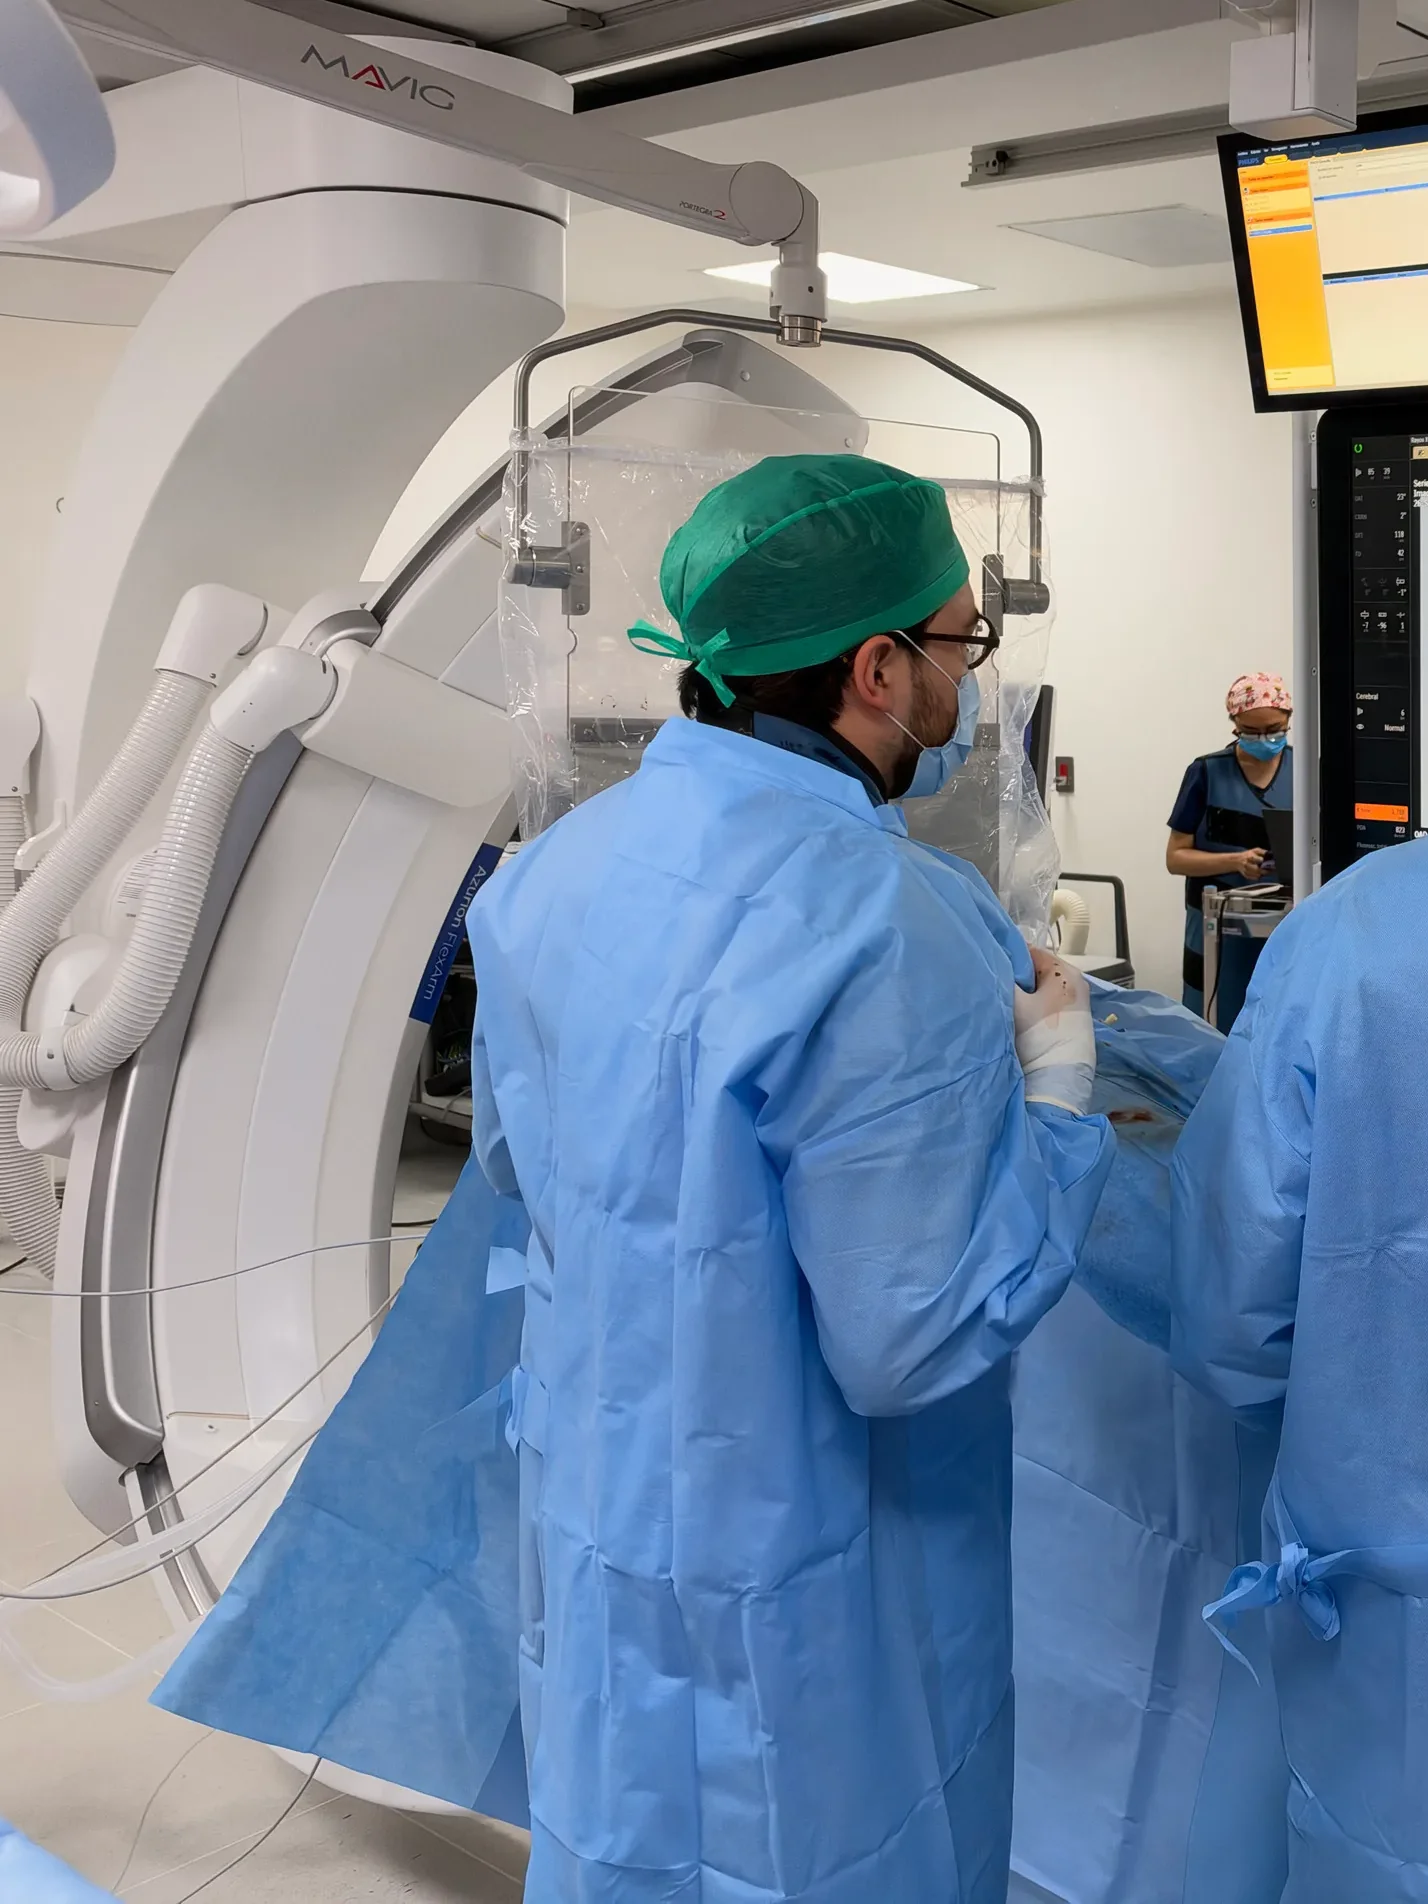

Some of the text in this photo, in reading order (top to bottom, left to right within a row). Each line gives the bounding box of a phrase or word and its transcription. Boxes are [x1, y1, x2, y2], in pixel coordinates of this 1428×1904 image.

[301, 44, 456, 111] MAVIG
[1356, 692, 1379, 700] Cerebral
[1384, 724, 1406, 732] Normal
[423, 865, 488, 1000] Azurion FlexArm
